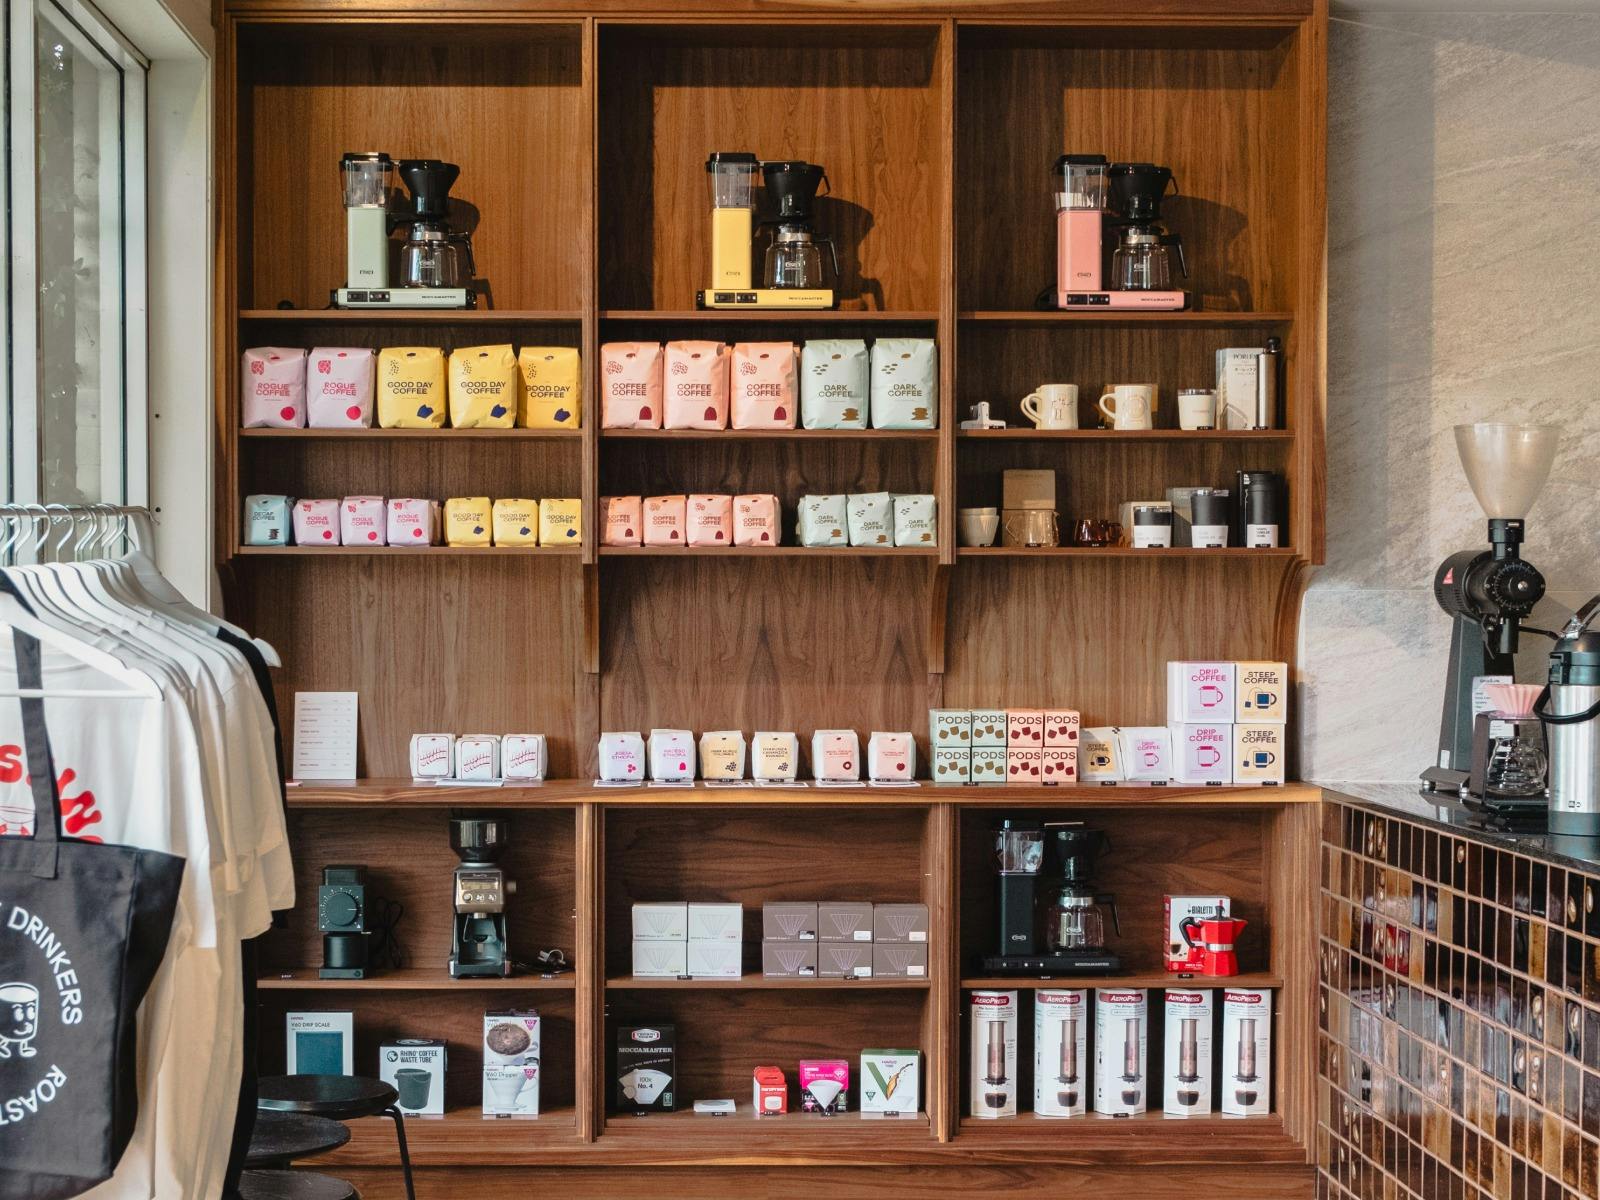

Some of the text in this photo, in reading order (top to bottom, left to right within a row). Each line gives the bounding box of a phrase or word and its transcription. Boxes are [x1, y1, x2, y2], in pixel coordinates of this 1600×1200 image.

[322, 388, 357, 396] COFFEE
[938, 716, 971, 725] PODS
[973, 715, 1006, 723] PODS
[1010, 716, 1043, 725] PODS
[1046, 716, 1079, 724] PODS
[936, 751, 970, 760] PODS
[973, 751, 1006, 759] PODS
[1008, 751, 1041, 760] PODS
[1043, 751, 1076, 760] PODS
[1192, 905, 1213, 914] BIALETTI
[7, 906, 83, 1025] DRINKERS
